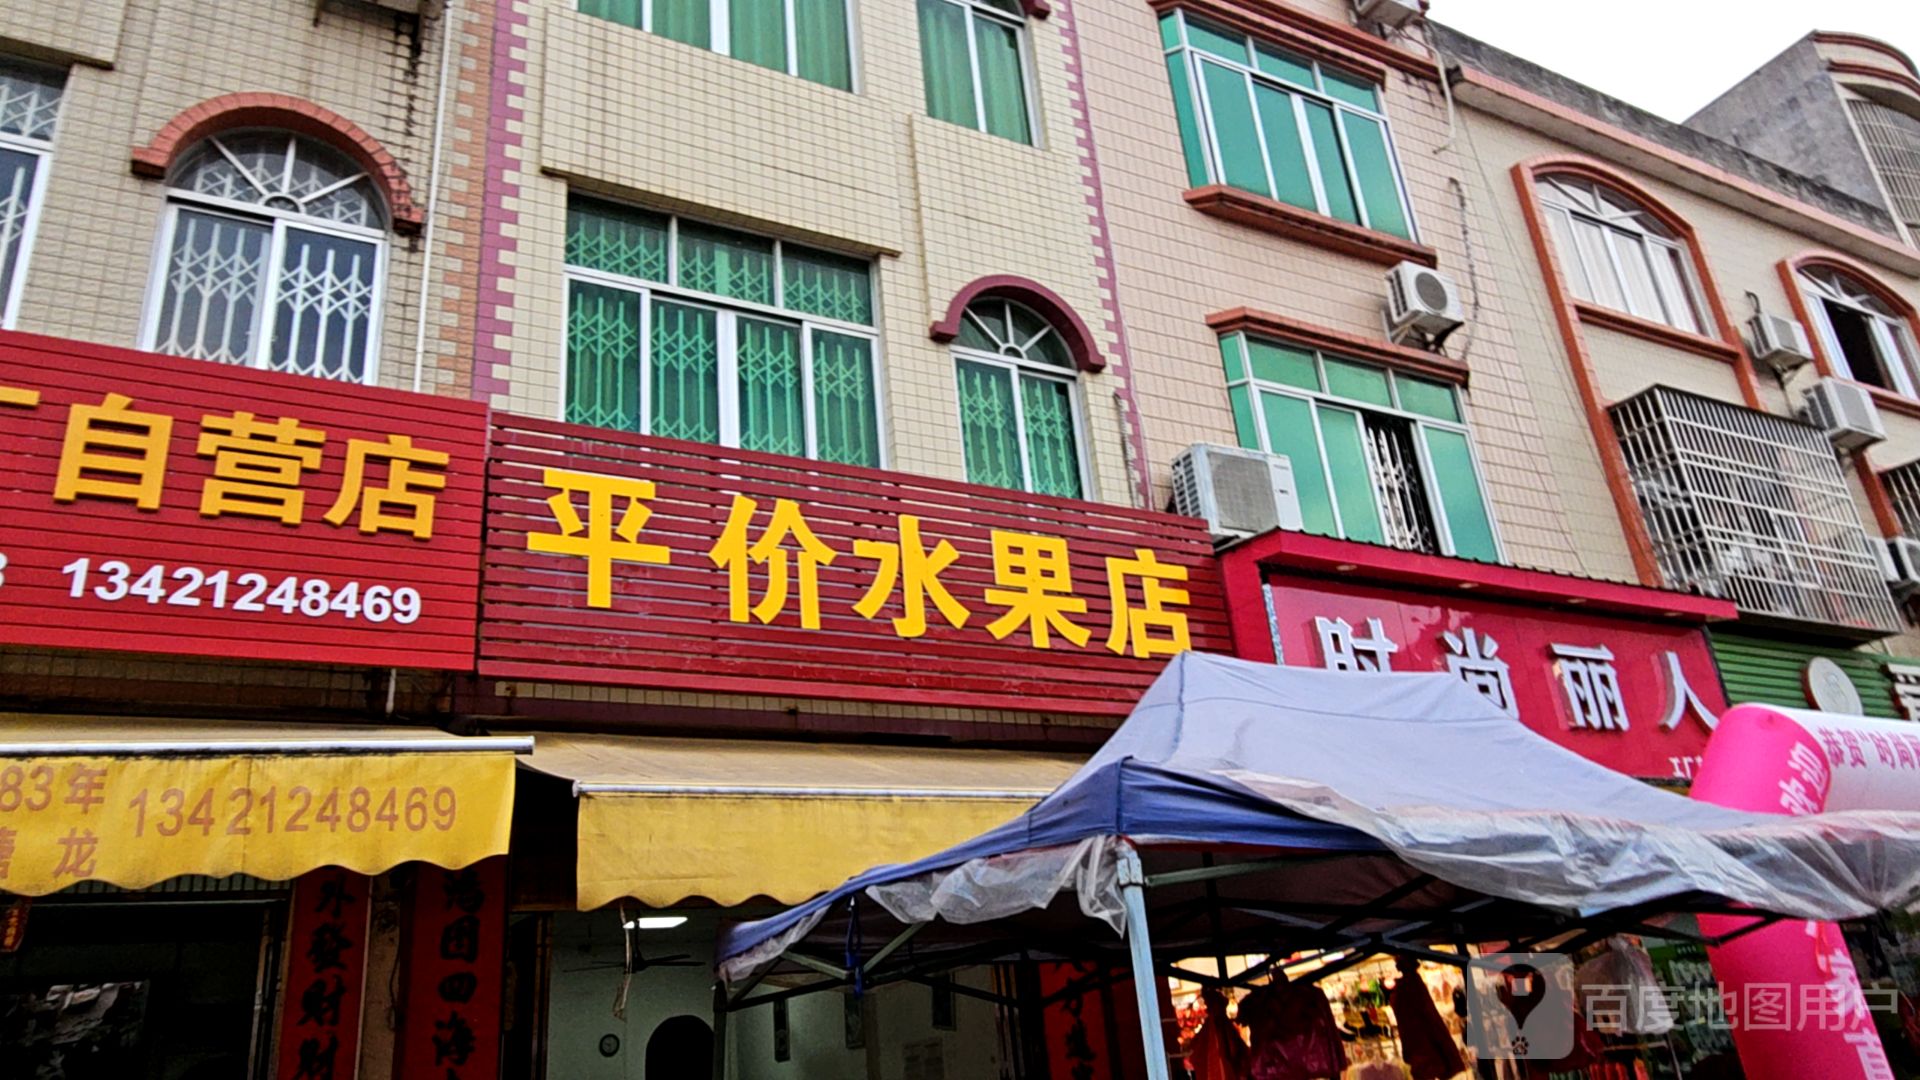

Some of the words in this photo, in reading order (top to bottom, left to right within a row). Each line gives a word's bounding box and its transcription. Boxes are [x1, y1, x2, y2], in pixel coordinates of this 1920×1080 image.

[62, 558, 421, 623] 13421248469
[527, 469, 1191, 659] 平价水果店
[1314, 616, 1720, 732] 时尚丽人
[128, 786, 457, 837] 13421248469
[53, 827, 98, 879] 龙
